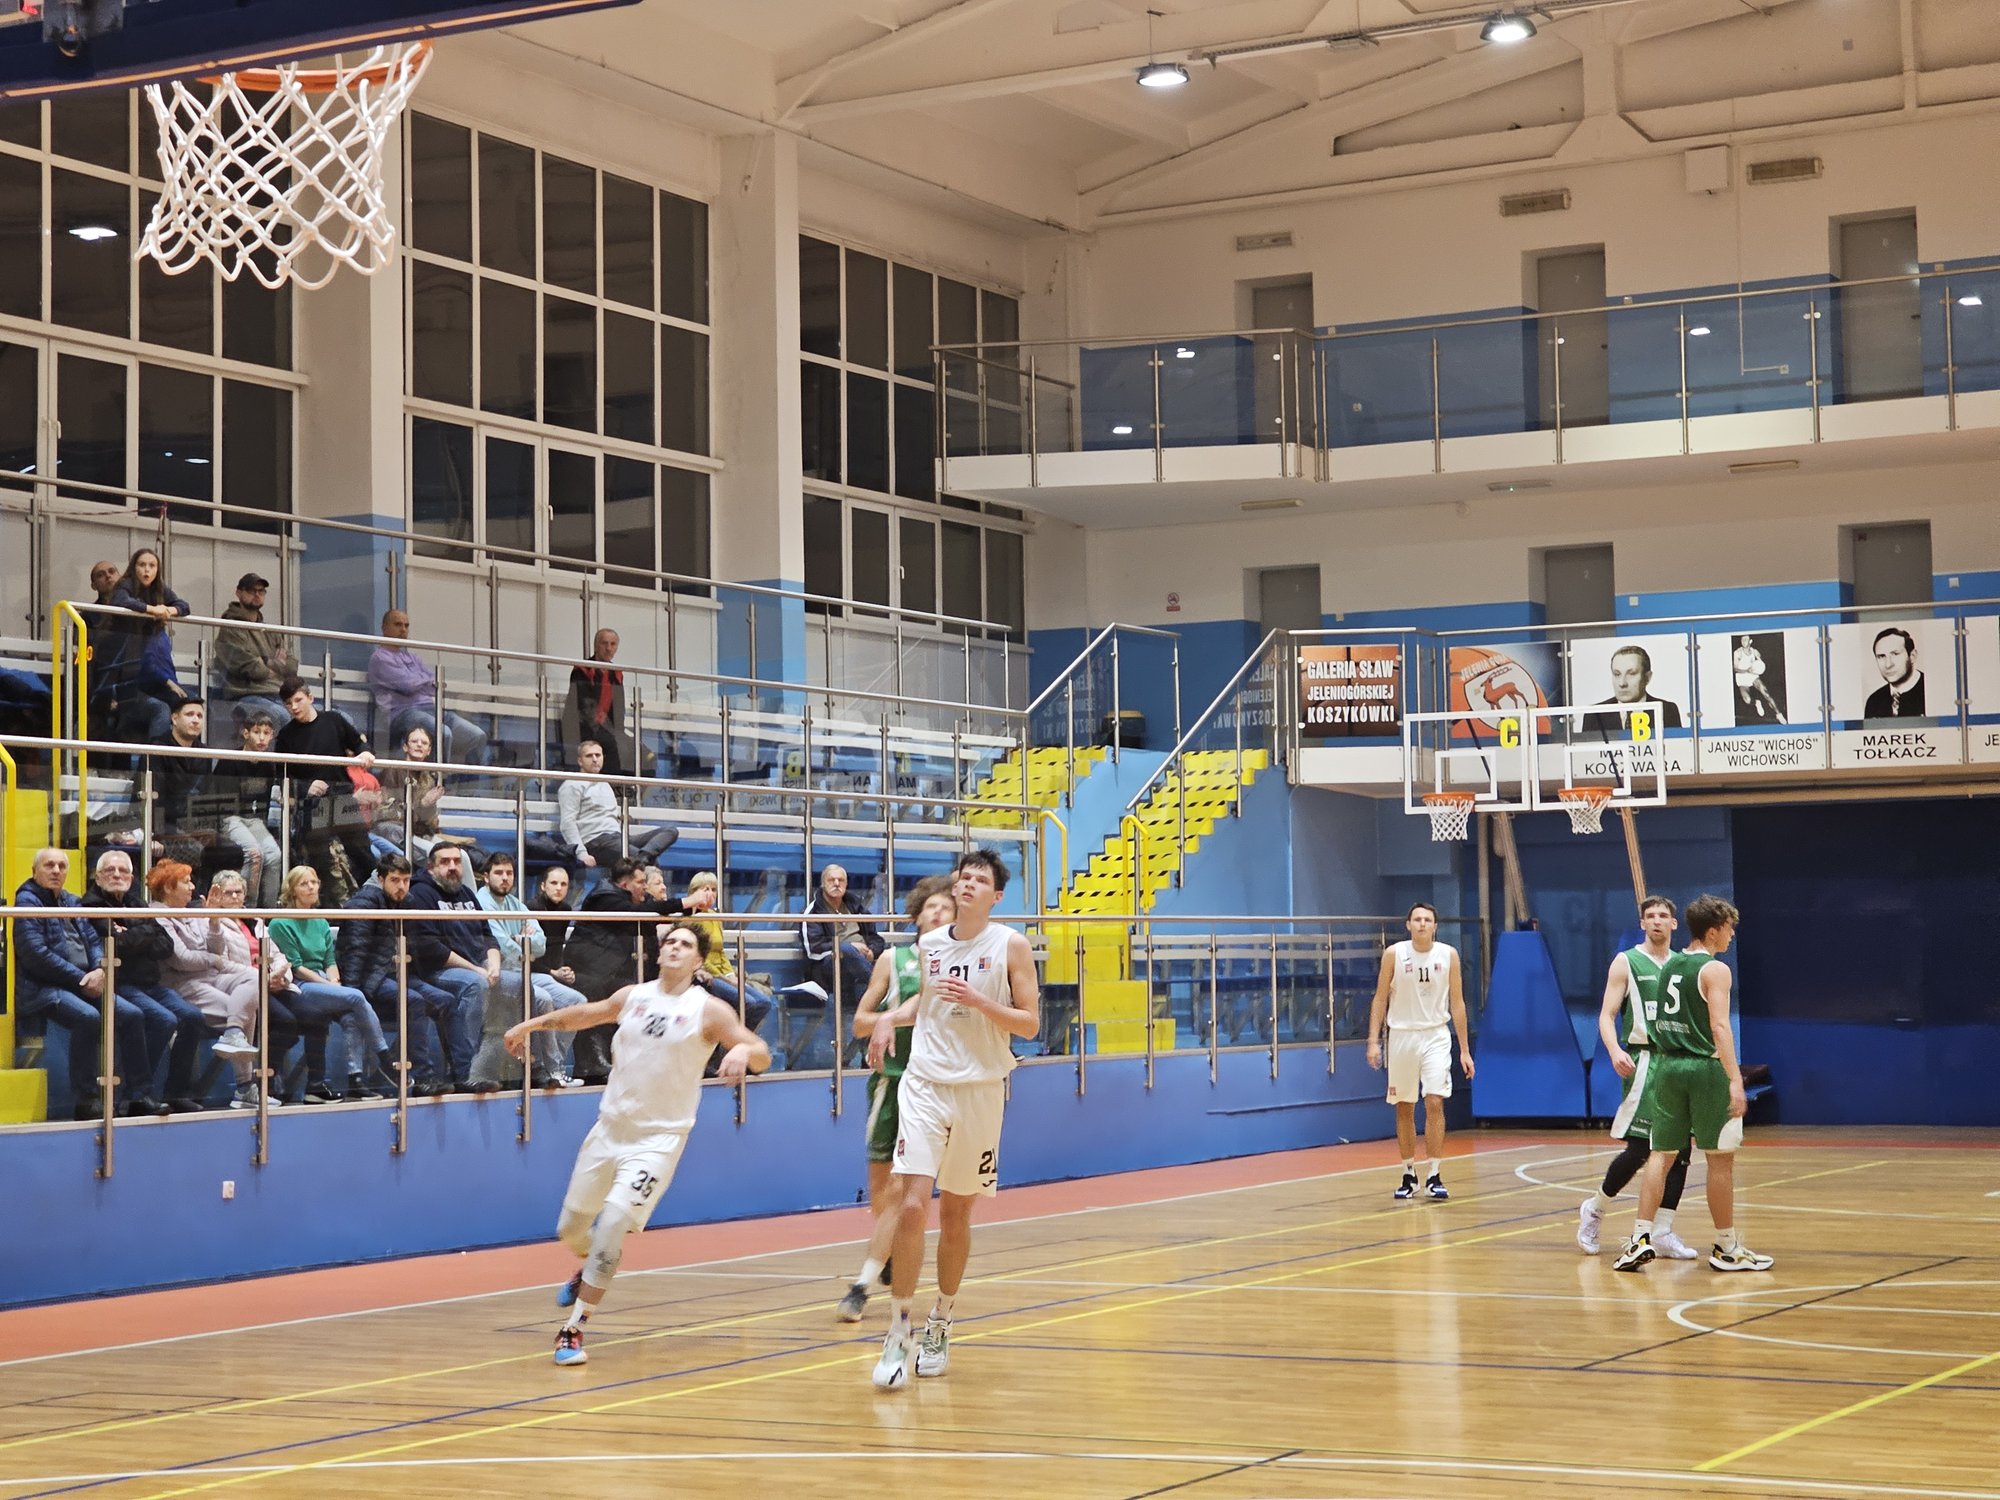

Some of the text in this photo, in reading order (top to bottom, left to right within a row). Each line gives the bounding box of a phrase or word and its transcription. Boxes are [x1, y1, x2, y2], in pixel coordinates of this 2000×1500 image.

[1307, 660, 1394, 679] GALERIA SŁAW
[1307, 682, 1394, 701] JELENIOGÓRSKIEJ
[1307, 703, 1395, 723] KOSZYKÓWKI
[1500, 718, 1519, 748] C
[1630, 711, 1651, 741] B
[1708, 736, 1819, 753] JANUSZ "WICHOŚ"
[1863, 733, 1927, 746] MAREK
[1984, 733, 2000, 746] JE
[1599, 744, 1667, 759] MARIA
[1727, 753, 1799, 767] WICHOWSKI
[1853, 746, 1937, 760] TOŁKACZ
[1418, 967, 1430, 983] 11
[1664, 974, 1683, 1015] 5
[978, 1148, 997, 1175] 21
